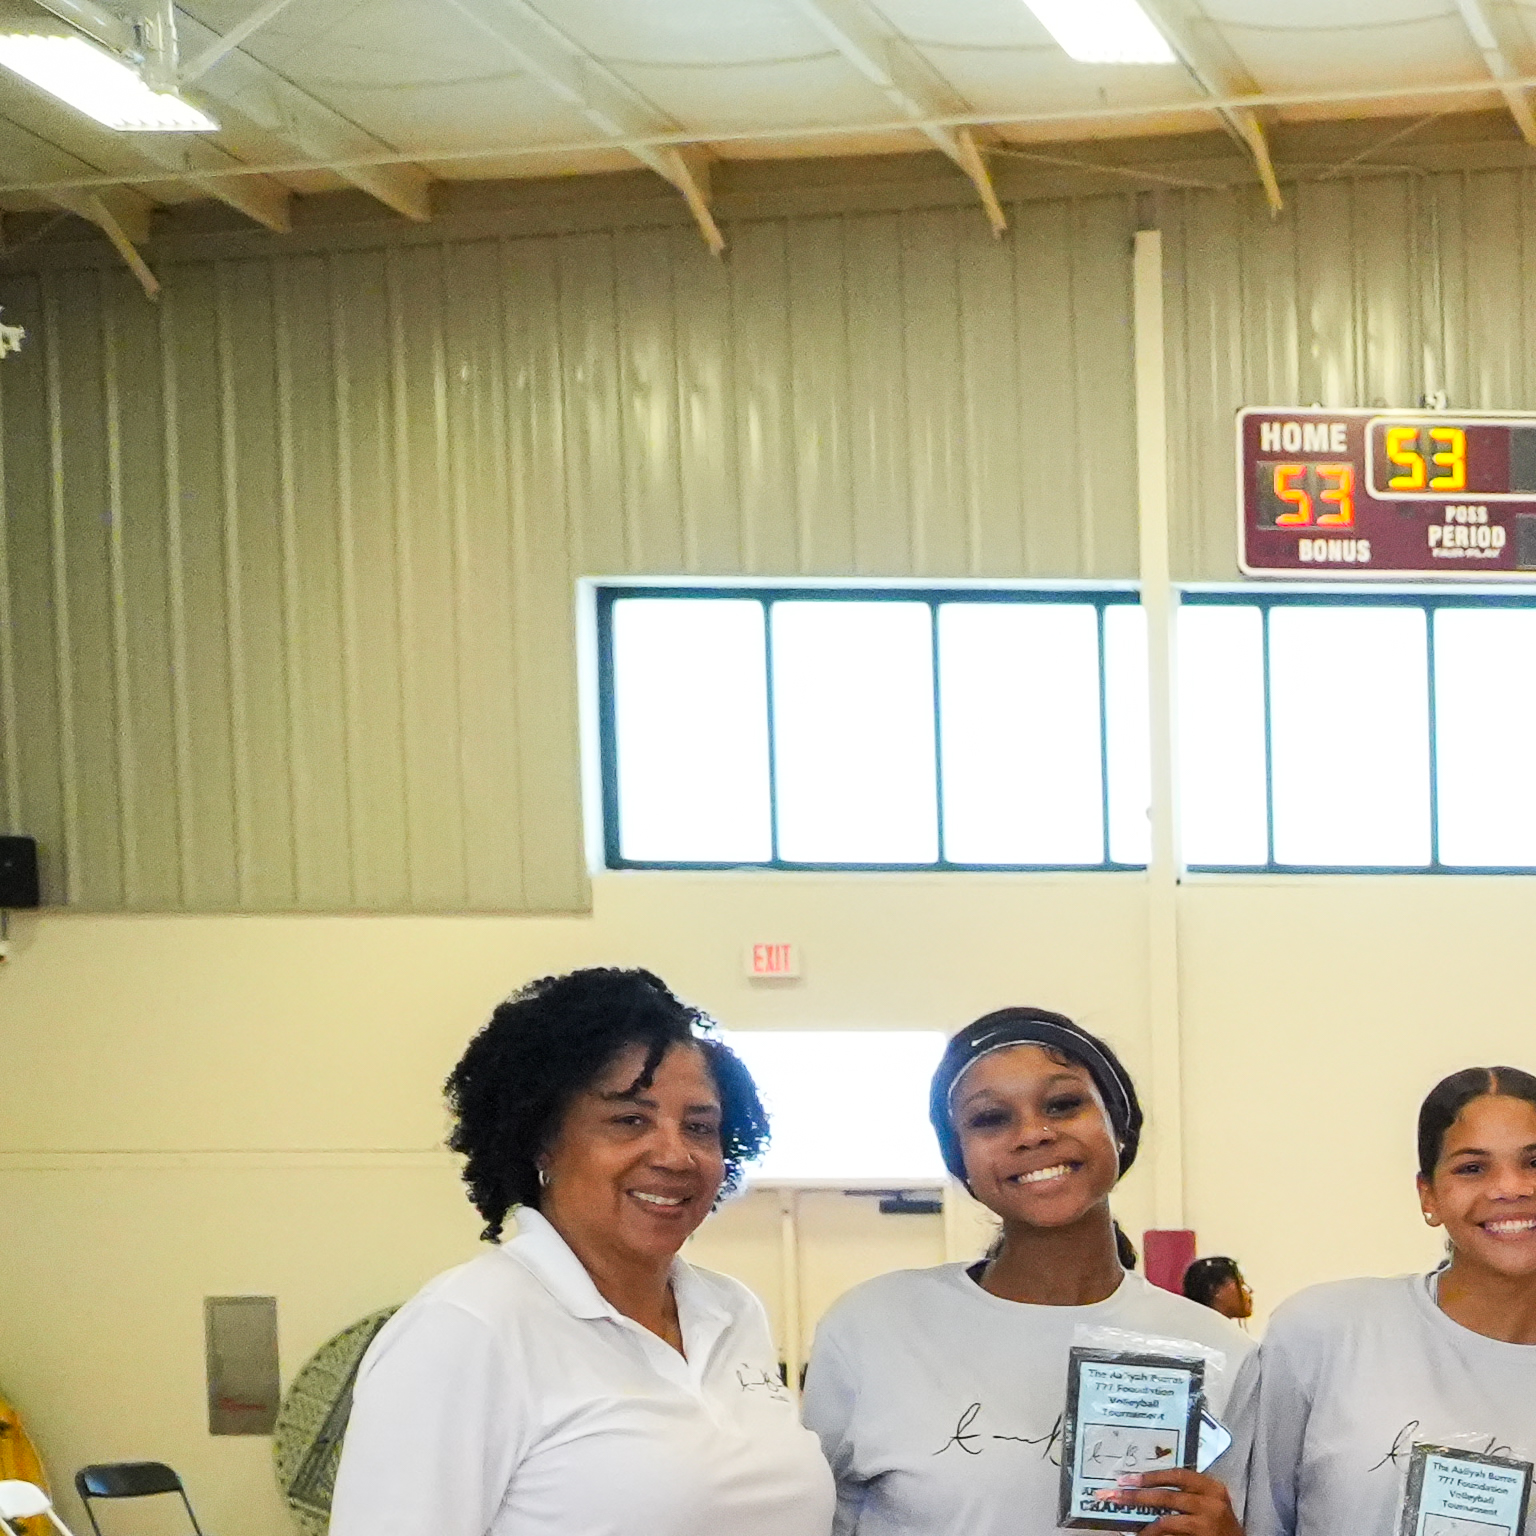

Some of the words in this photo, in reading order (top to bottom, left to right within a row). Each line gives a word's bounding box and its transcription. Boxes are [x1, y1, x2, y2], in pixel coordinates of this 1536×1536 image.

[1261, 423, 1348, 453] HOME
[1386, 427, 1466, 490] 53
[1274, 465, 1355, 527] 53
[1428, 524, 1506, 548] PERIOD
[1299, 538, 1370, 564] BONUS
[753, 944, 791, 972] EXIT
[1433, 1462, 1449, 1473] The
[1452, 1466, 1486, 1479] Aaliyah
[1438, 1475, 1454, 1485] 777
